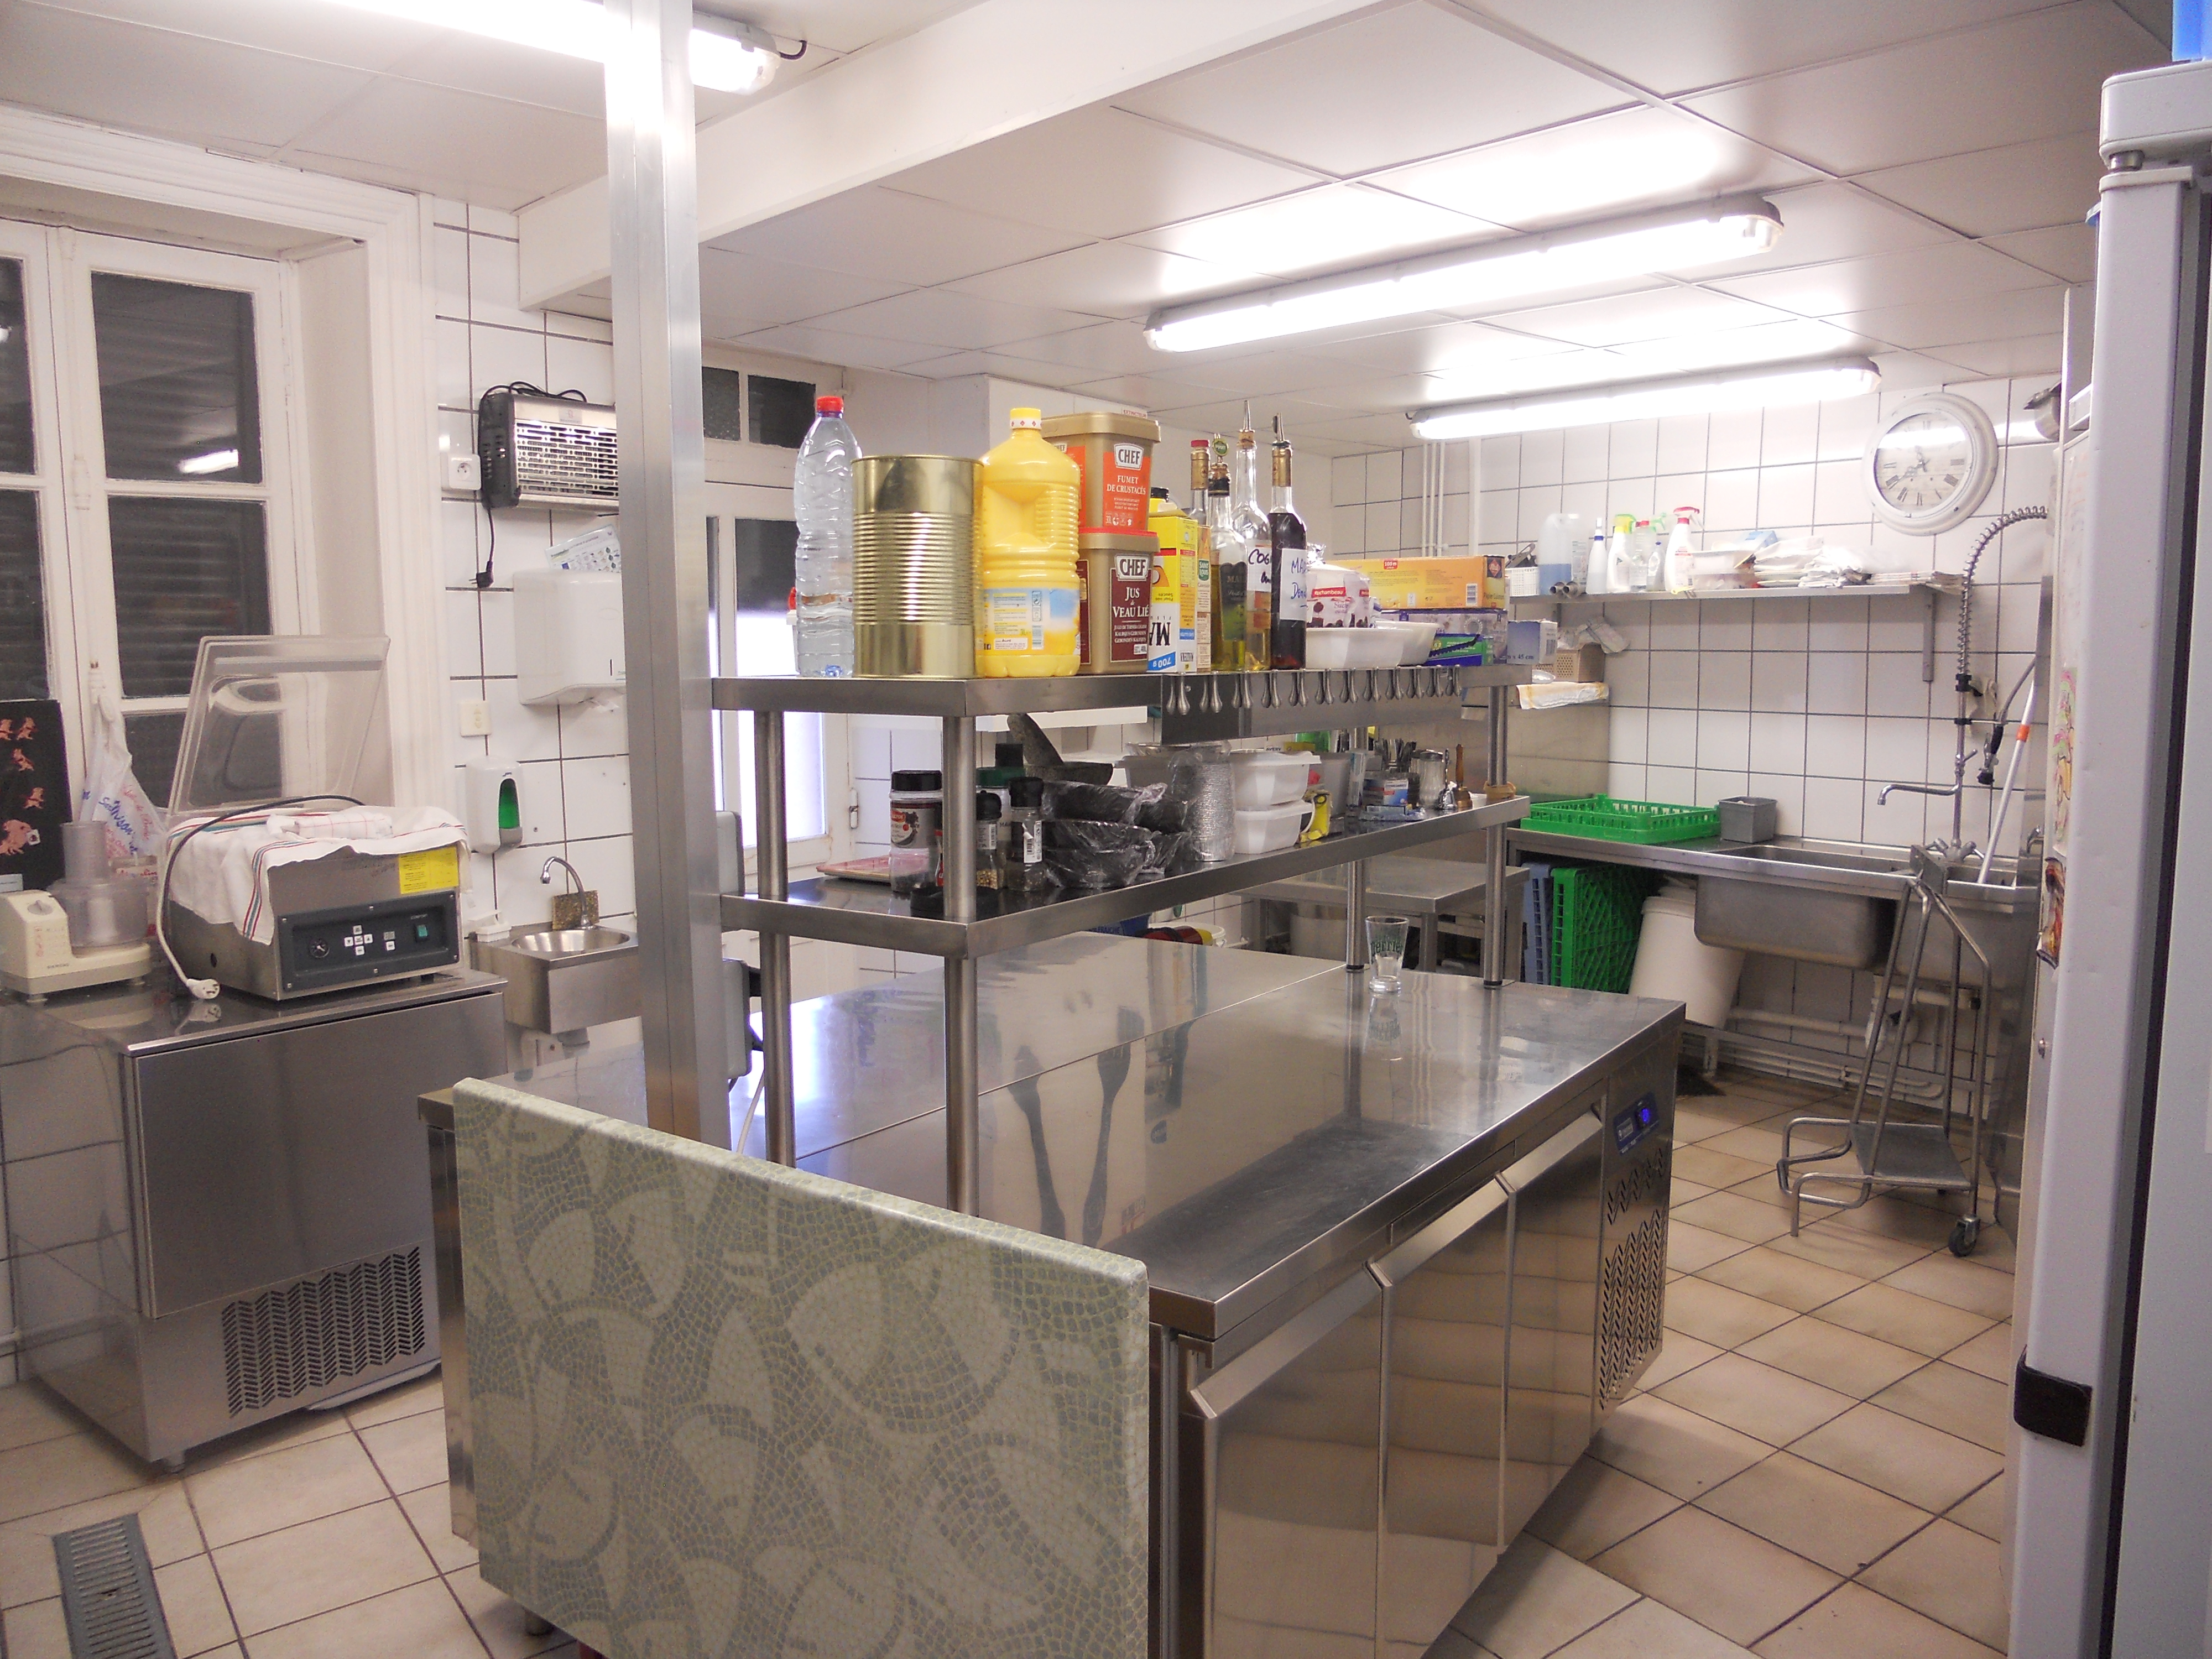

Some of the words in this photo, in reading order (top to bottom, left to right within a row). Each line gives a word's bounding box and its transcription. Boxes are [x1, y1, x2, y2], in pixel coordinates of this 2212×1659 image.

[1118, 448, 1141, 465] CHEF
[1117, 475, 1139, 484] FUMET
[1117, 485, 1146, 495] CRUSTACÉS
[1119, 559, 1146, 576] CHEF
[1125, 587, 1140, 601] JUS
[1113, 606, 1136, 618] VEAU
[1137, 606, 1150, 618] LIÉ
[1158, 657, 1172, 667] 700
